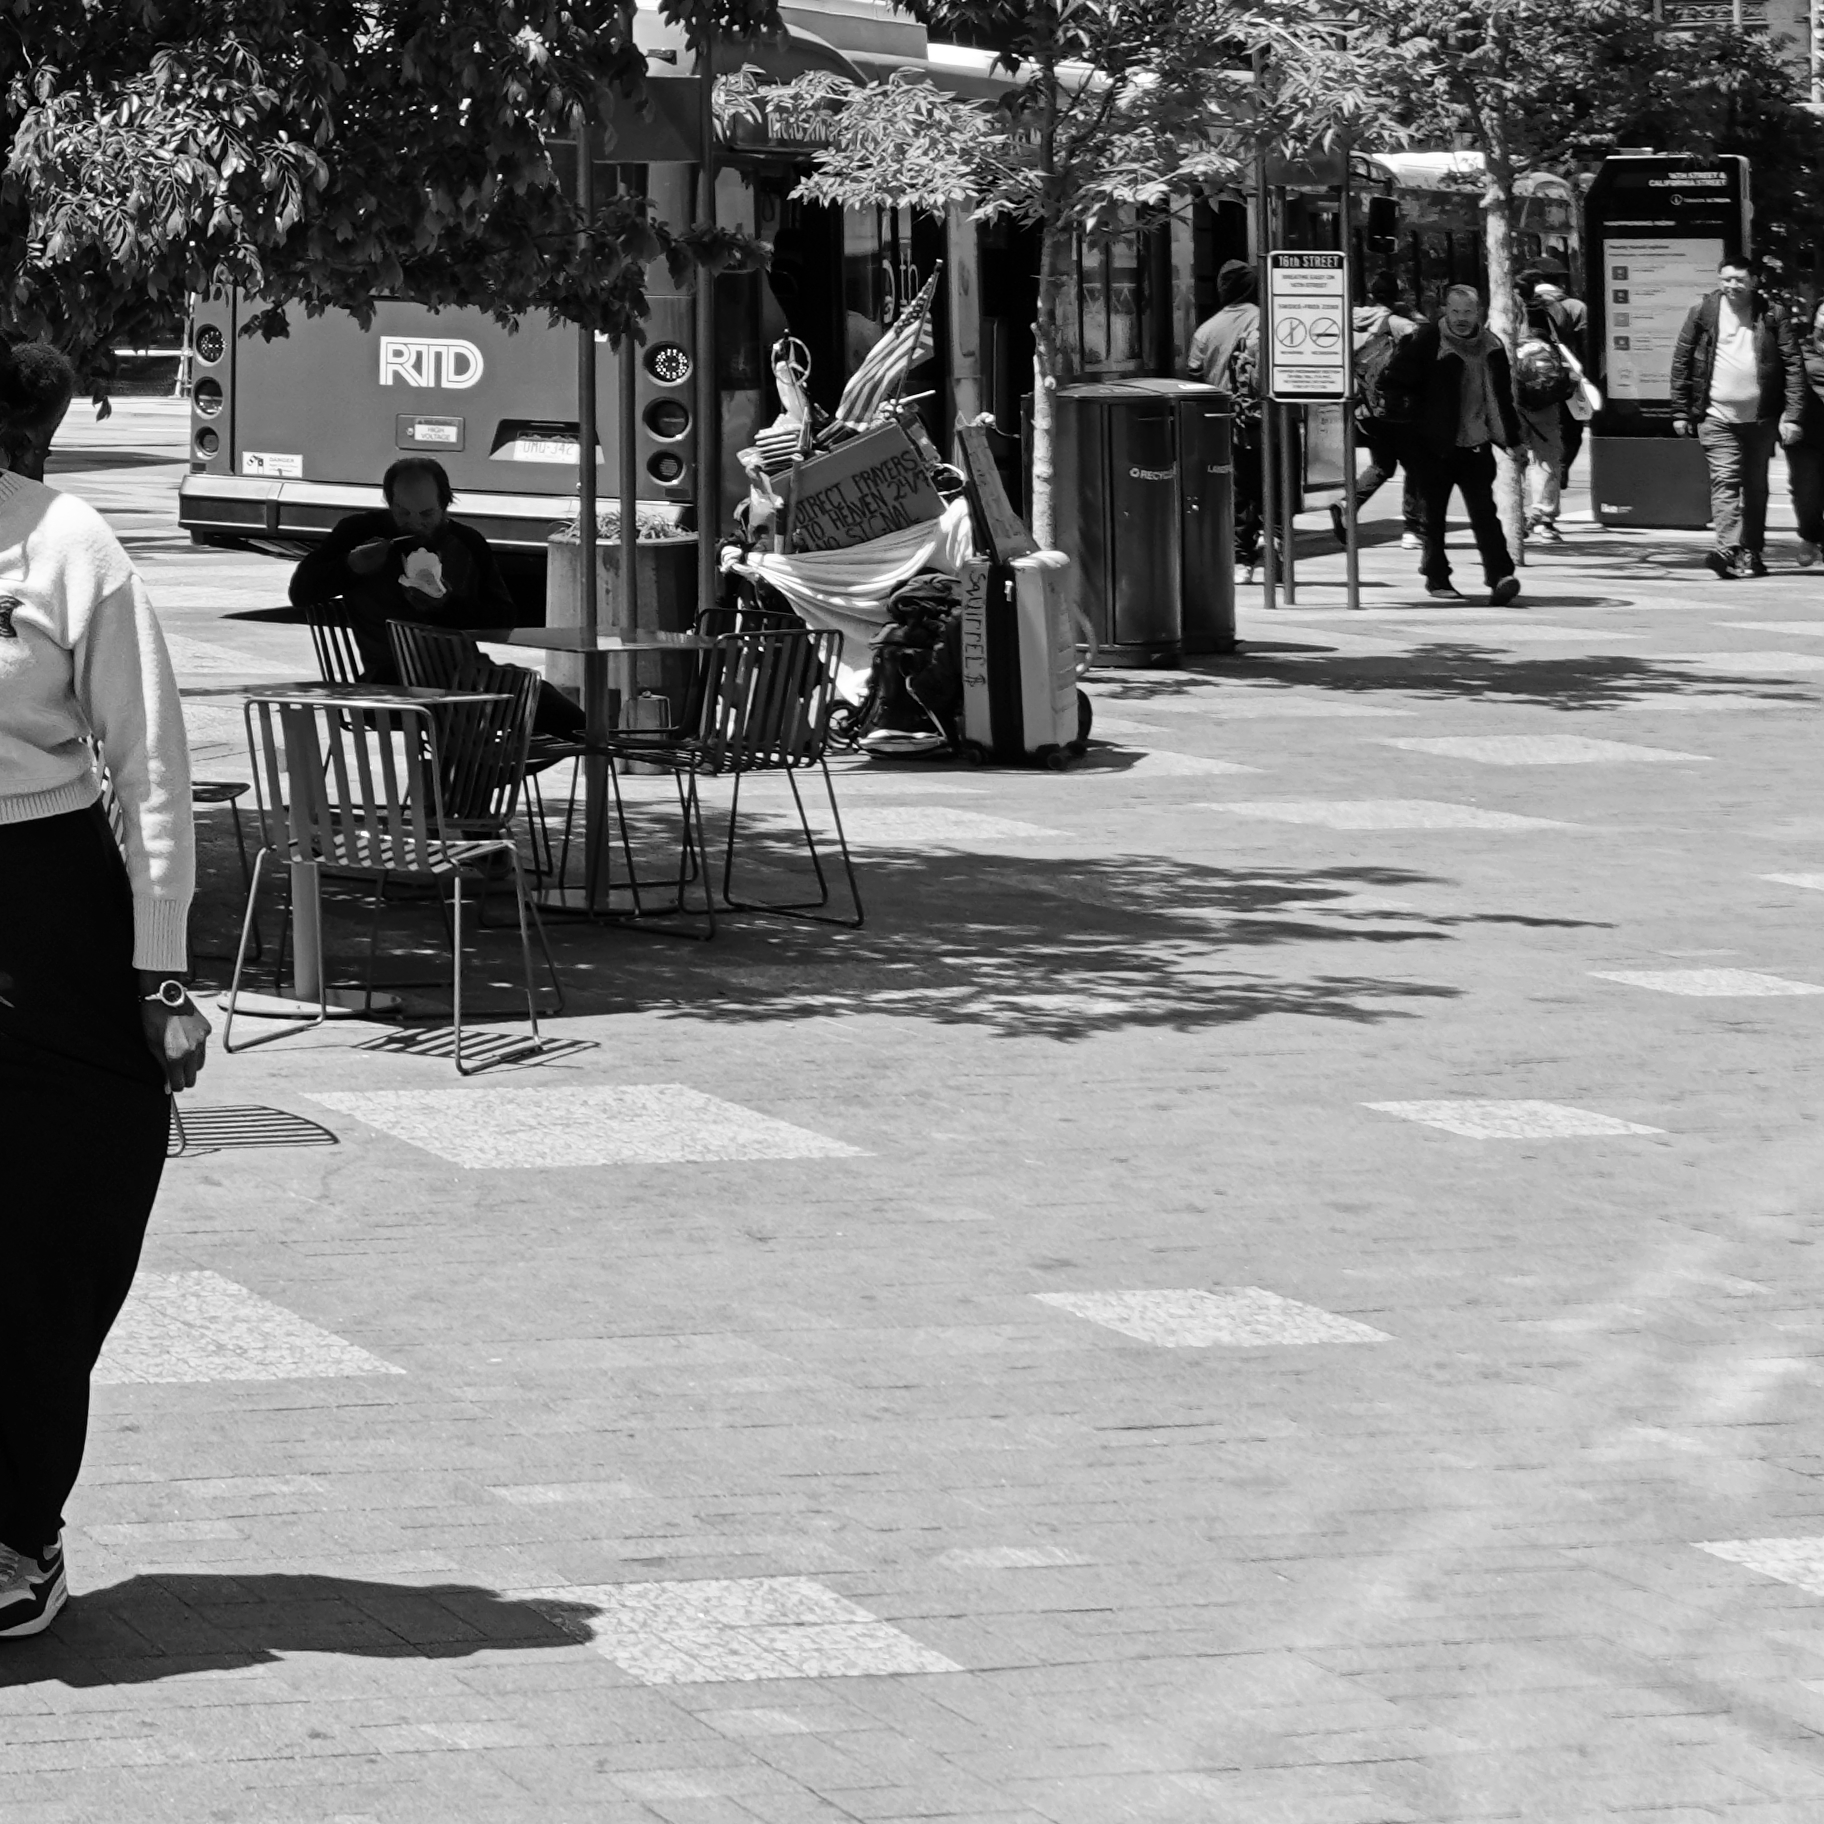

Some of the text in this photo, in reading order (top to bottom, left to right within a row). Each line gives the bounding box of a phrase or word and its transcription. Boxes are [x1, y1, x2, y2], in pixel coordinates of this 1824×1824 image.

[1278, 255, 1339, 267] 16th STREET
[379, 336, 485, 389] RTD
[421, 433, 451, 441] VOLTAGE
[852, 450, 918, 494] PRAYERS
[801, 521, 825, 543] TO
[828, 488, 889, 531] HEAVEN
